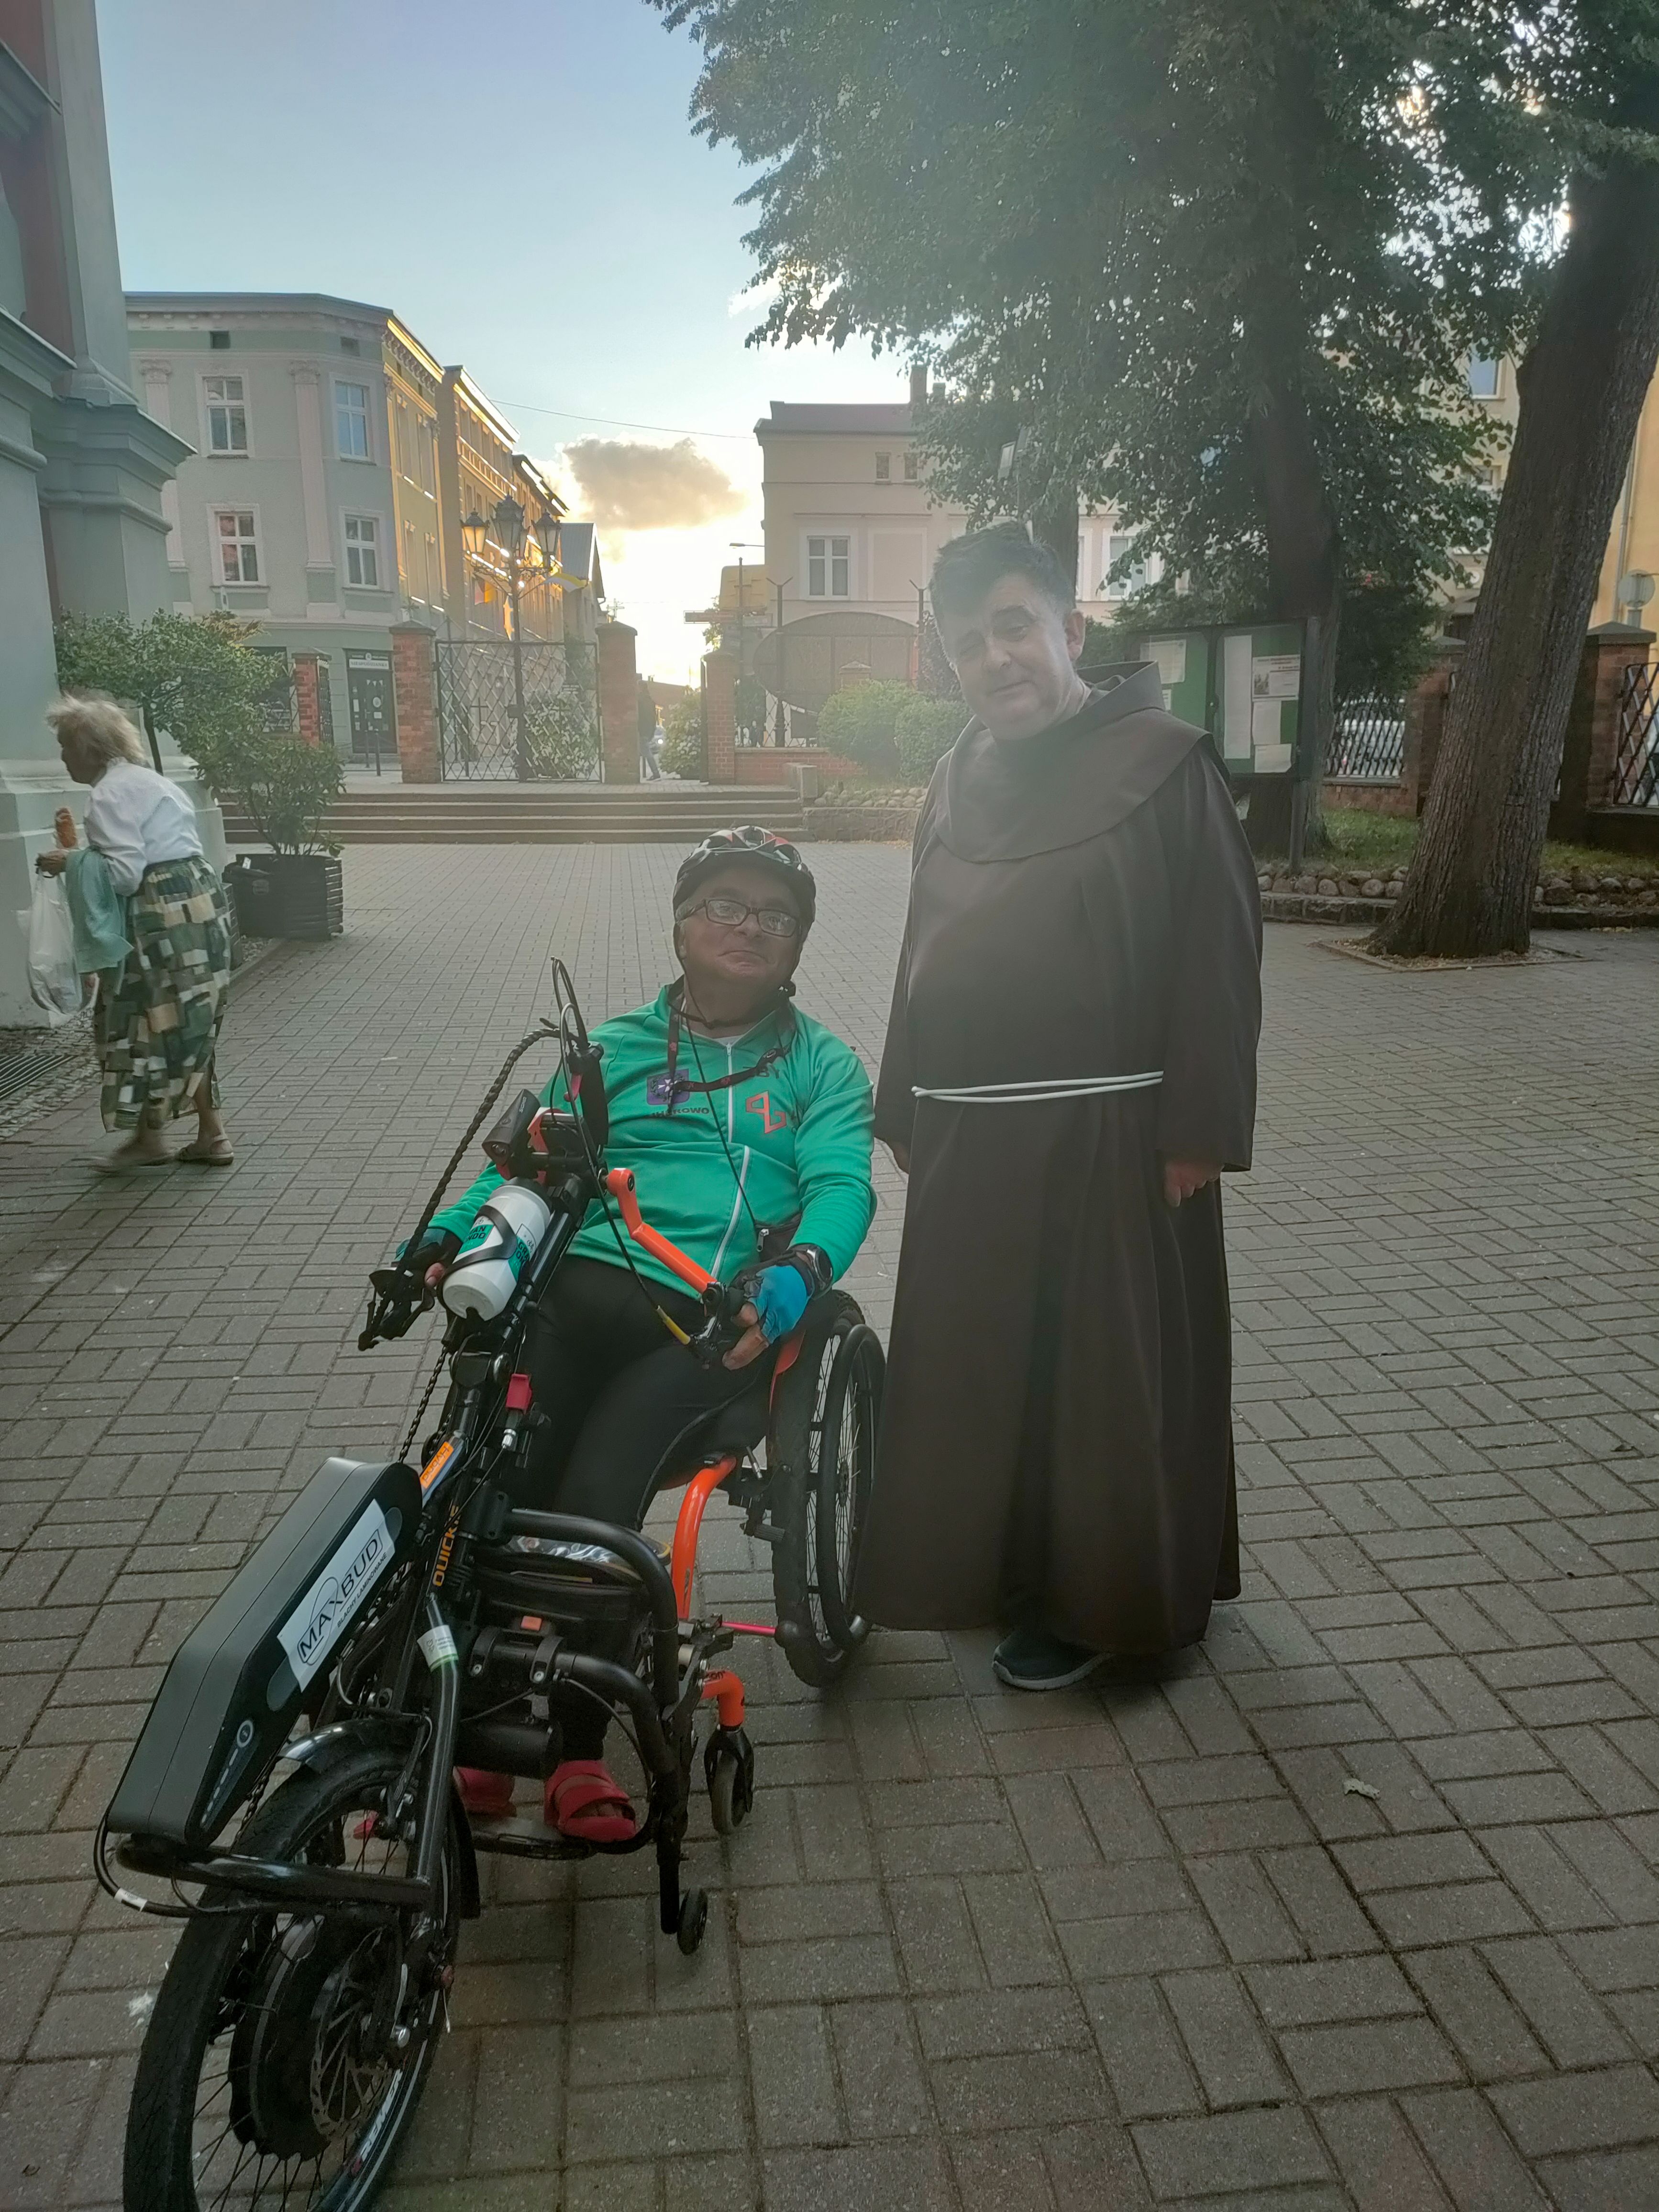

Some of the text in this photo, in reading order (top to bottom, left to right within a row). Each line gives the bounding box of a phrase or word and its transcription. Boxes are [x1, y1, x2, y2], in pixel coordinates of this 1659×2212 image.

[422, 1447, 449, 1482] Hybrid
[300, 1539, 378, 1658] MAXBUD
[337, 1552, 387, 1627] BLACHY LAMINOWANE
